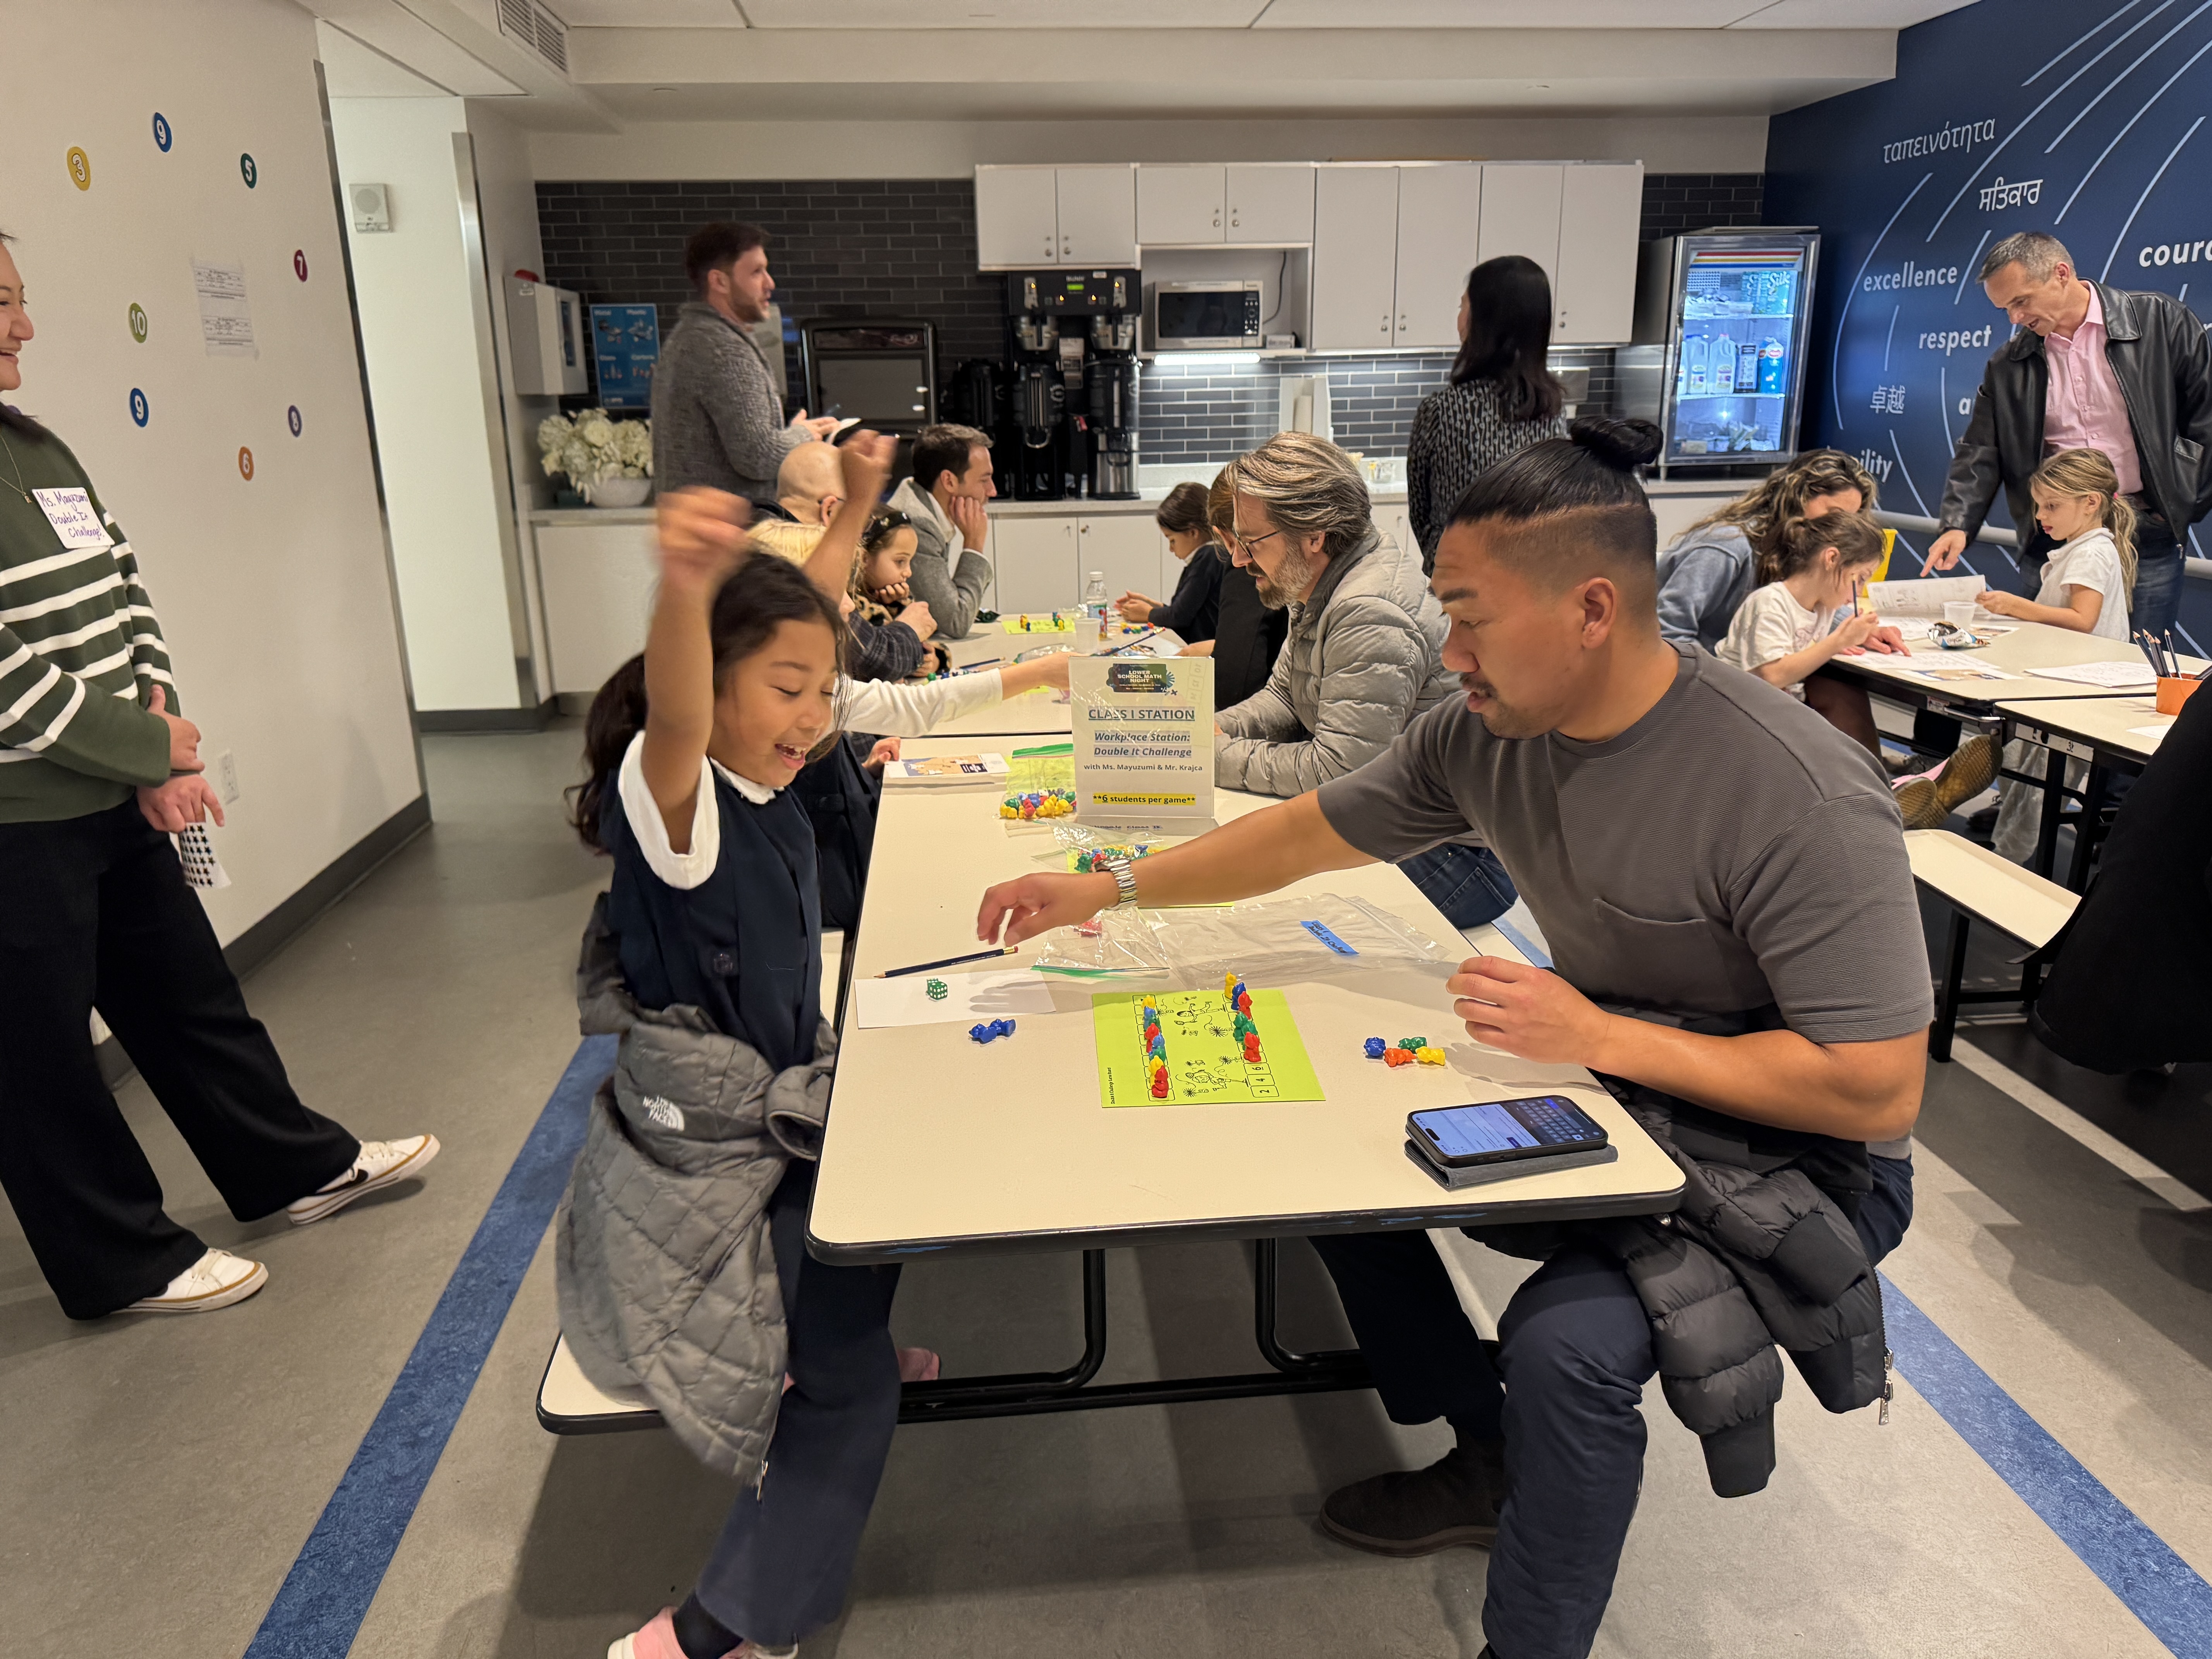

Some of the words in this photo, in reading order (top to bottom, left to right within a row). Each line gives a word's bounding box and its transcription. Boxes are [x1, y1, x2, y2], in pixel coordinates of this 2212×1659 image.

[156, 120, 166, 145] 9
[1883, 118, 1995, 163] ταπεινότητα
[72, 153, 86, 181] 3
[245, 159, 252, 182] 5
[1979, 177, 2043, 211] ਸਤਿਕਾਰ
[297, 256, 303, 276] 7
[1863, 261, 1957, 291] excellence
[1767, 271, 1790, 289] Silk
[132, 310, 146, 336] 10
[1919, 325, 1992, 356] respect
[135, 395, 144, 420] 9
[1870, 384, 1905, 414] 卓越
[291, 411, 299, 432] 8
[242, 453, 249, 474] 6
[36, 491, 56, 507] Ms.
[49, 511, 78, 524] Double
[1089, 709, 1127, 719] CLASS
[1139, 710, 1194, 720] STATION
[1095, 733, 1147, 743] Workplace
[1094, 747, 1128, 756] Double
[1142, 748, 1192, 758] Challenge
